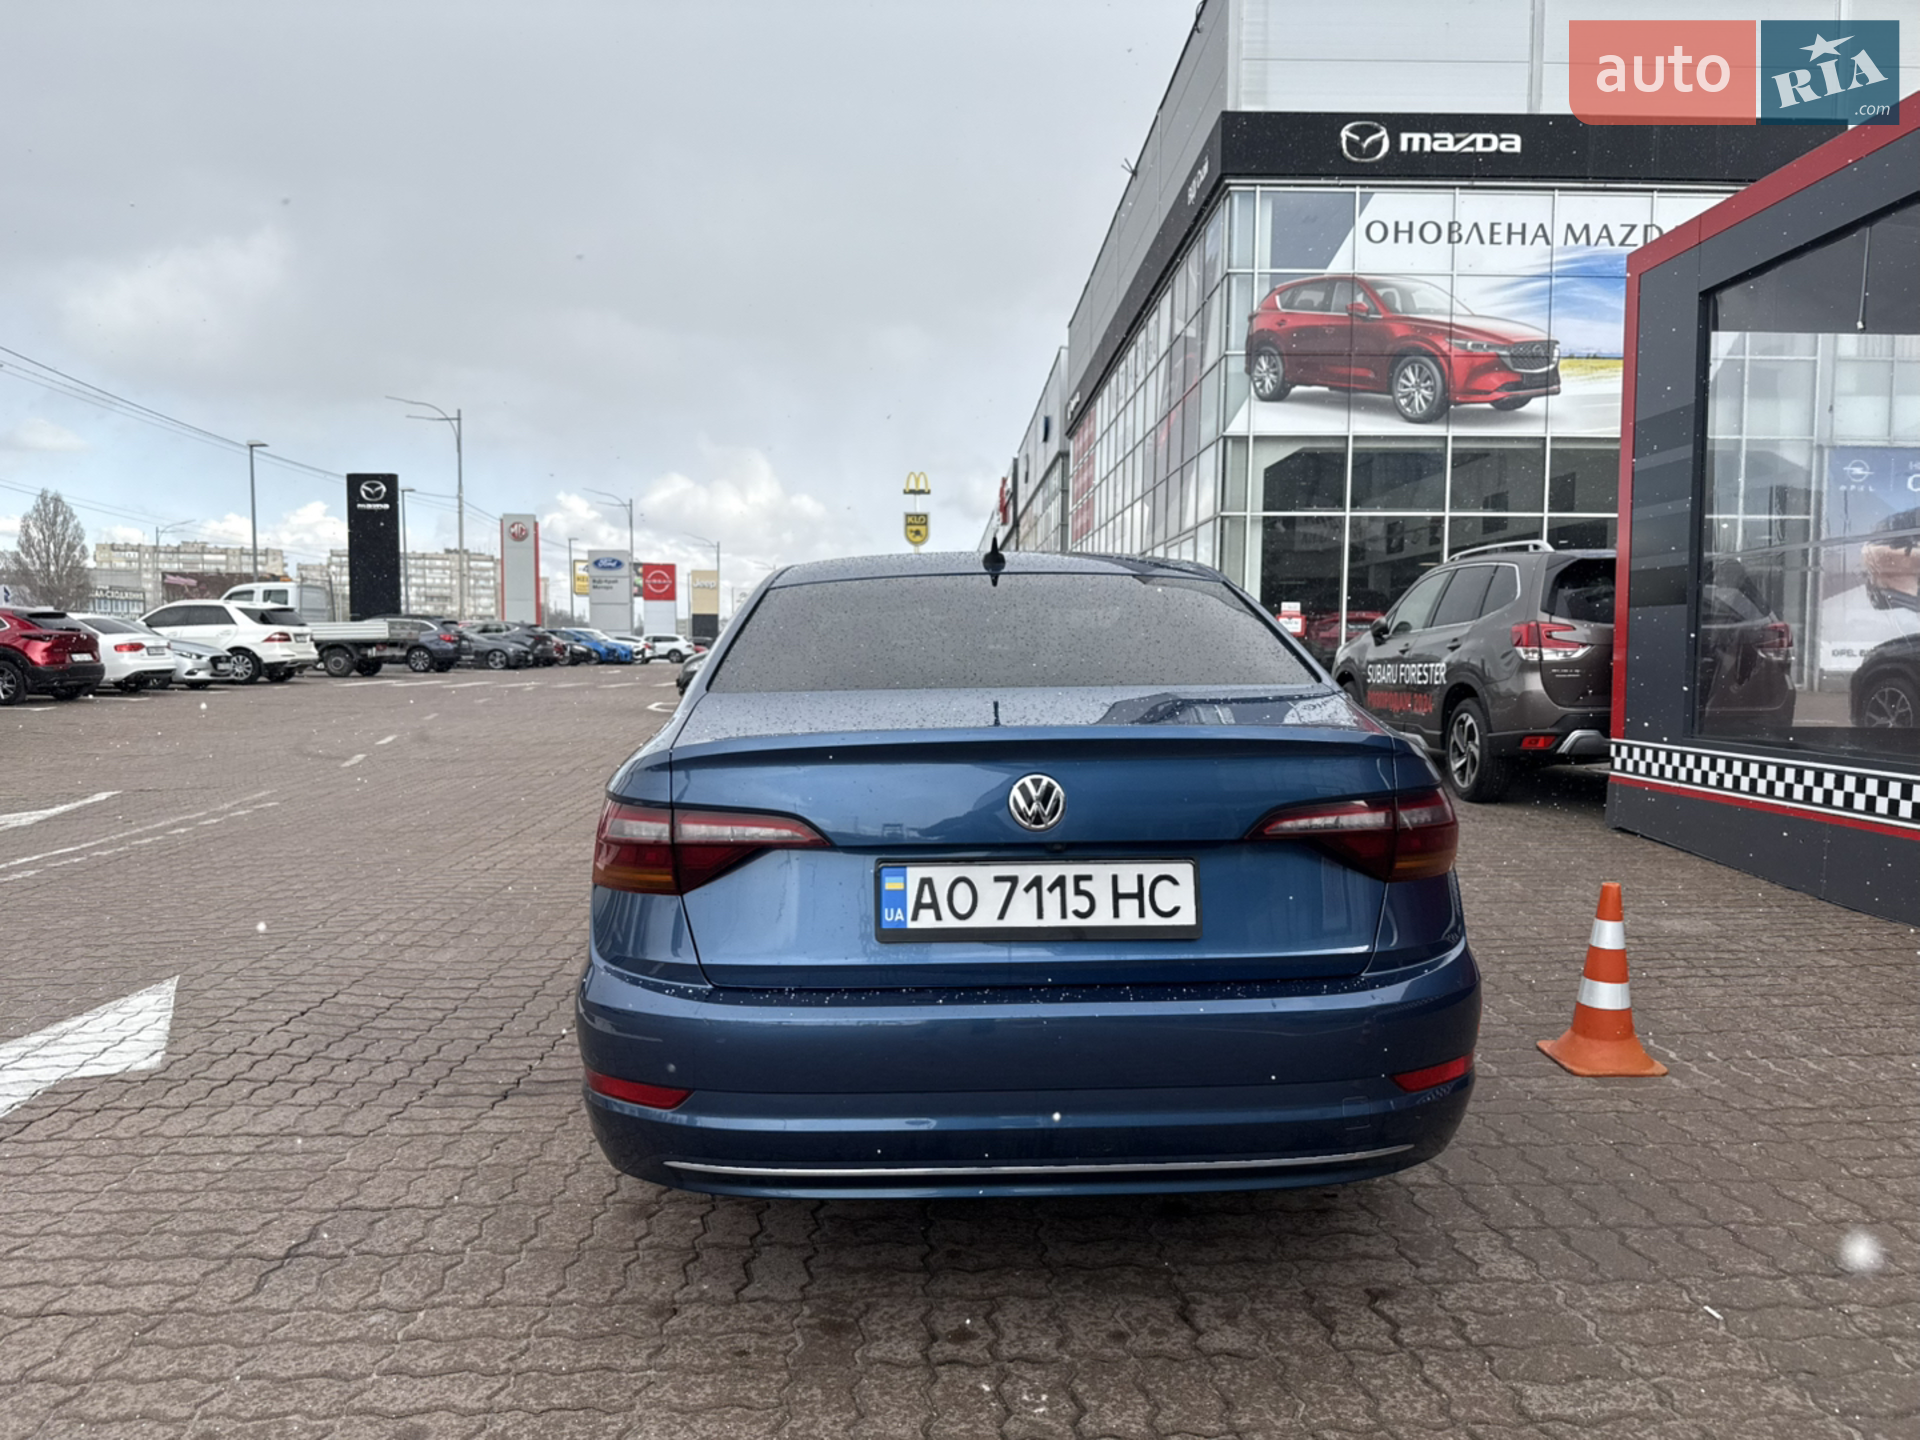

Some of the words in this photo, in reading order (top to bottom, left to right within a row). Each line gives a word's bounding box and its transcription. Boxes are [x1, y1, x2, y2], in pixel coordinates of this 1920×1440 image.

[1365, 218, 1552, 248] ОНОВЛЕНА
[1562, 222, 1681, 248] MAZD
[692, 578, 717, 590] Jeep
[1366, 663, 1398, 684] SUBARU
[1399, 661, 1447, 685] FORESTER
[910, 876, 979, 921] AO
[992, 874, 1097, 921] 7115
[1111, 873, 1181, 920] HC
[884, 908, 905, 922] UA
